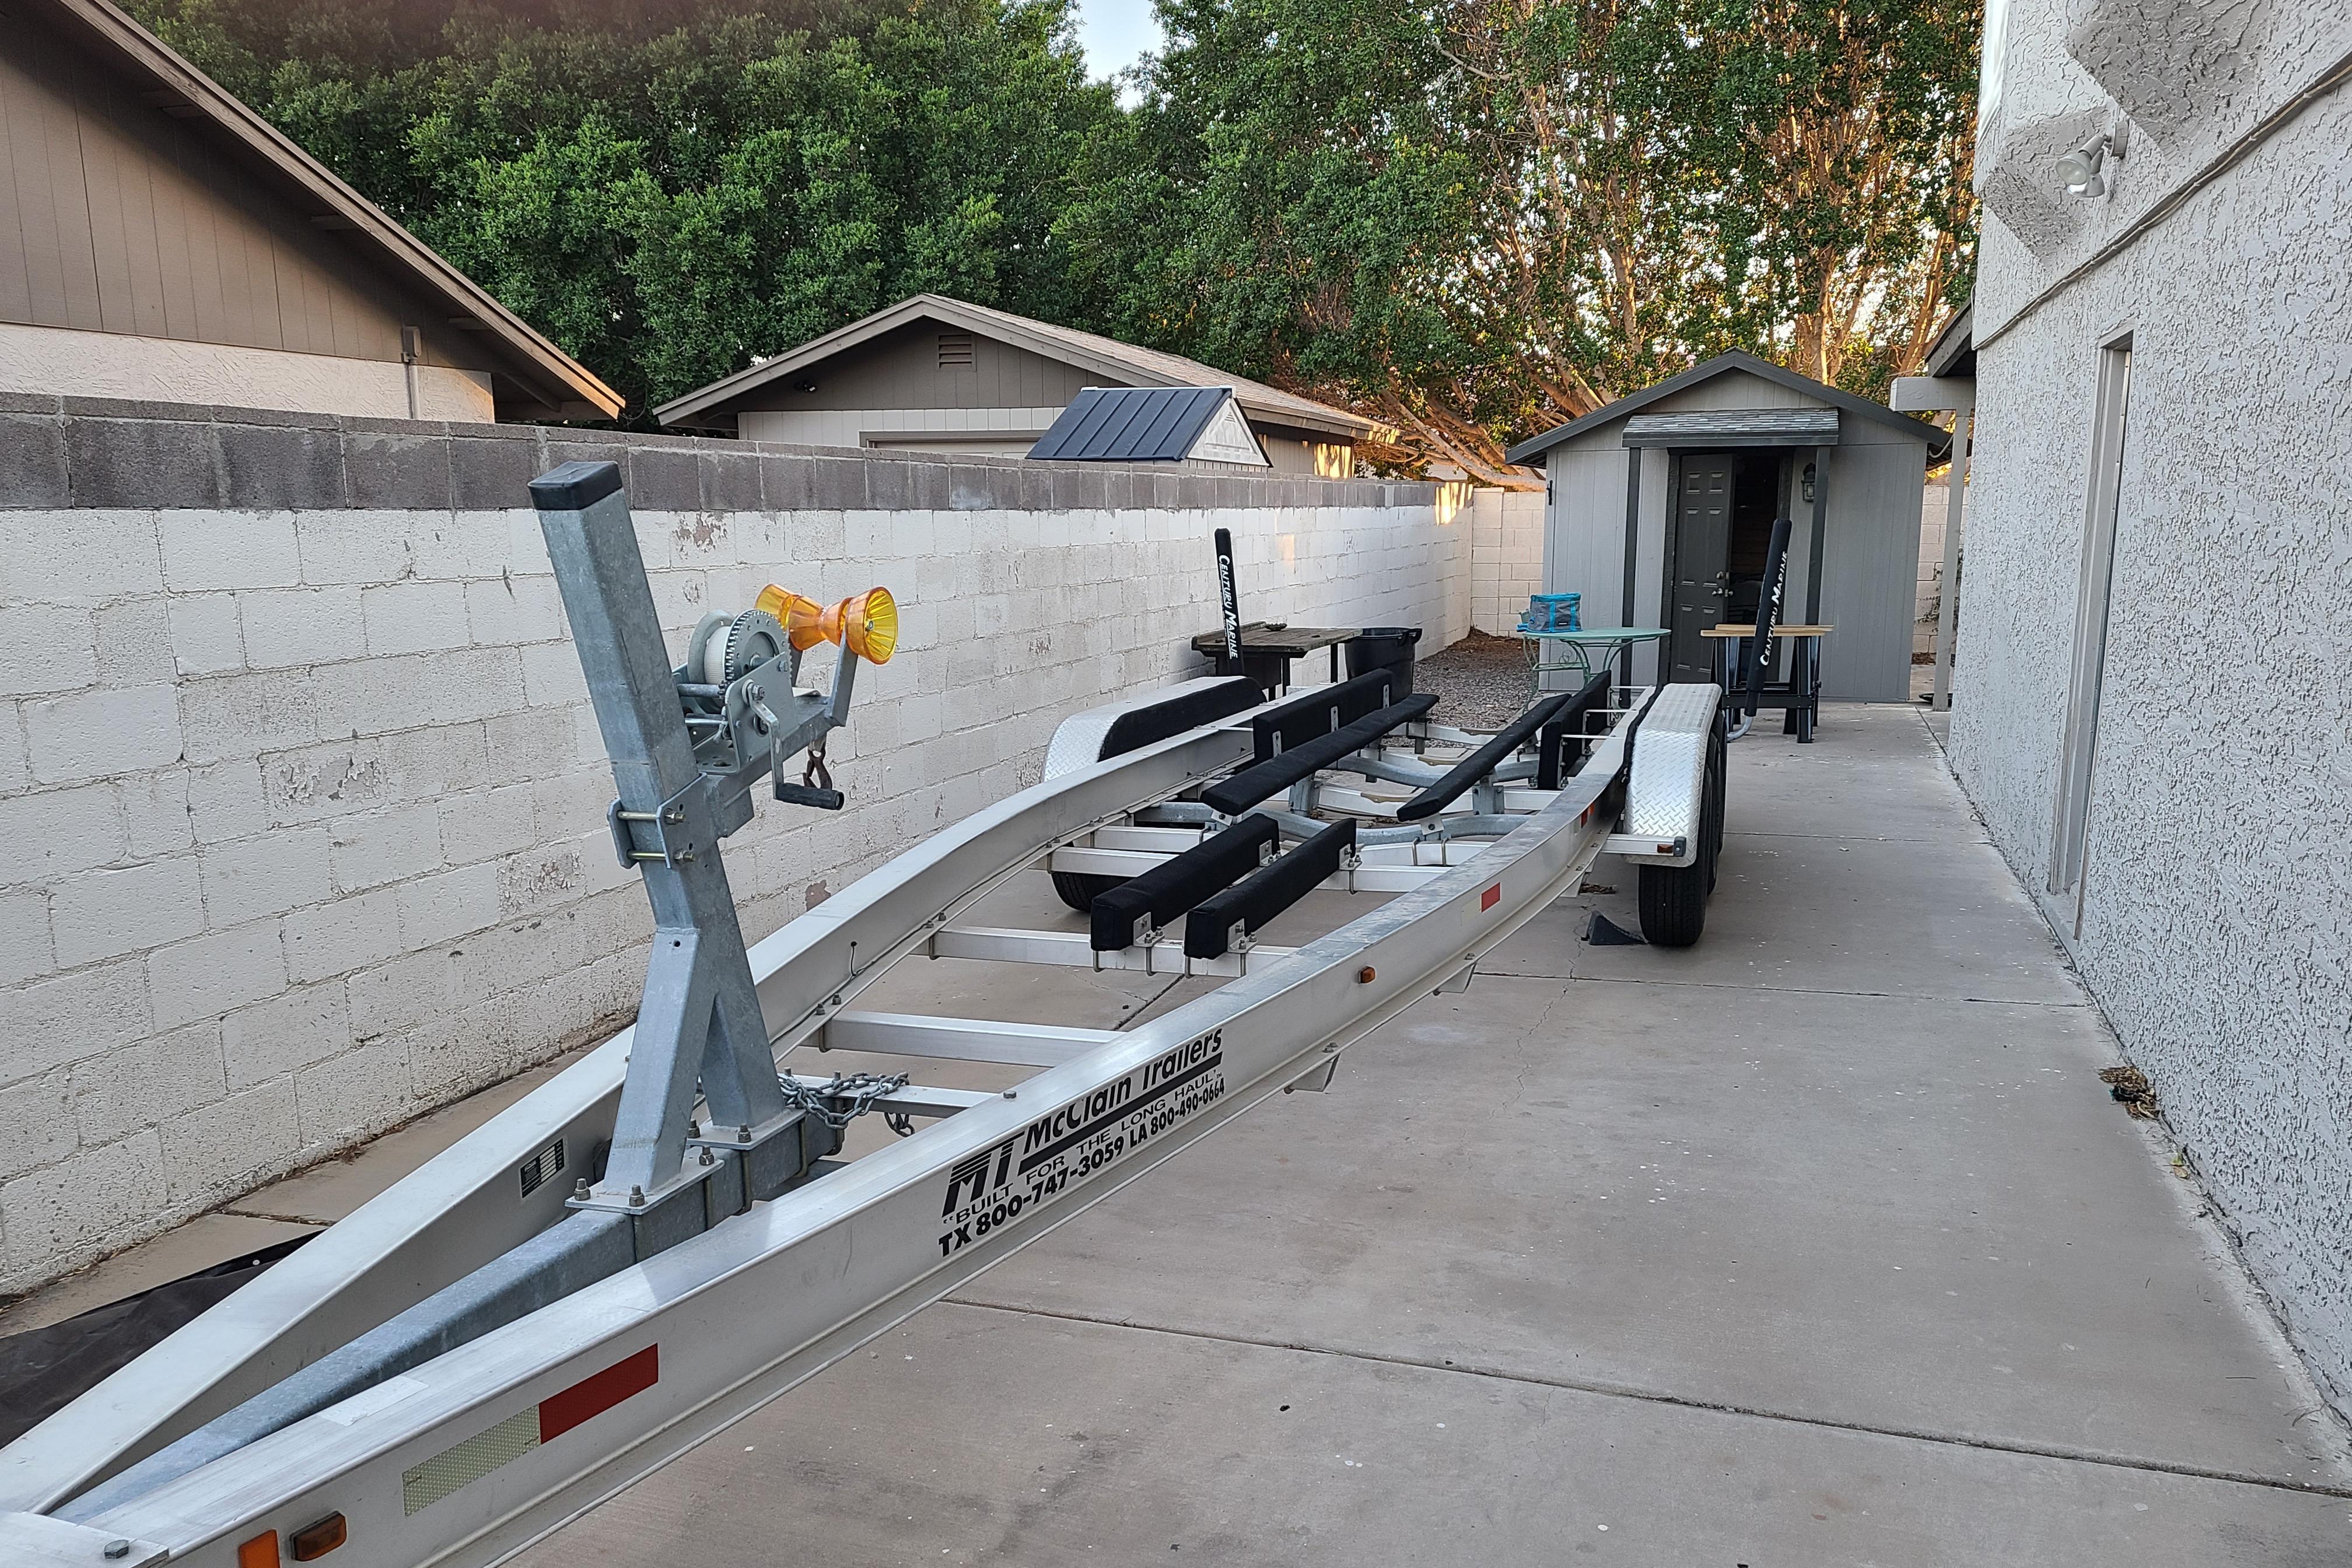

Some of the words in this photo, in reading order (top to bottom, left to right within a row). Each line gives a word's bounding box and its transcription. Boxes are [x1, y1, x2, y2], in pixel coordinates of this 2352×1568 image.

[1771, 551, 1787, 606] MARINE
[1225, 610, 1238, 659] MARINE
[1023, 1076, 1132, 1155] McClain
[1026, 1156, 1065, 1185] FOR
[1076, 1129, 1111, 1155] THE
[1121, 1099, 1166, 1132] LONG
[938, 1221, 972, 1258] TX
[976, 1136, 1124, 1236] 800-747-3059
[1129, 1123, 1147, 1149] LA
[1150, 1077, 1224, 1136] 800-490-0664
